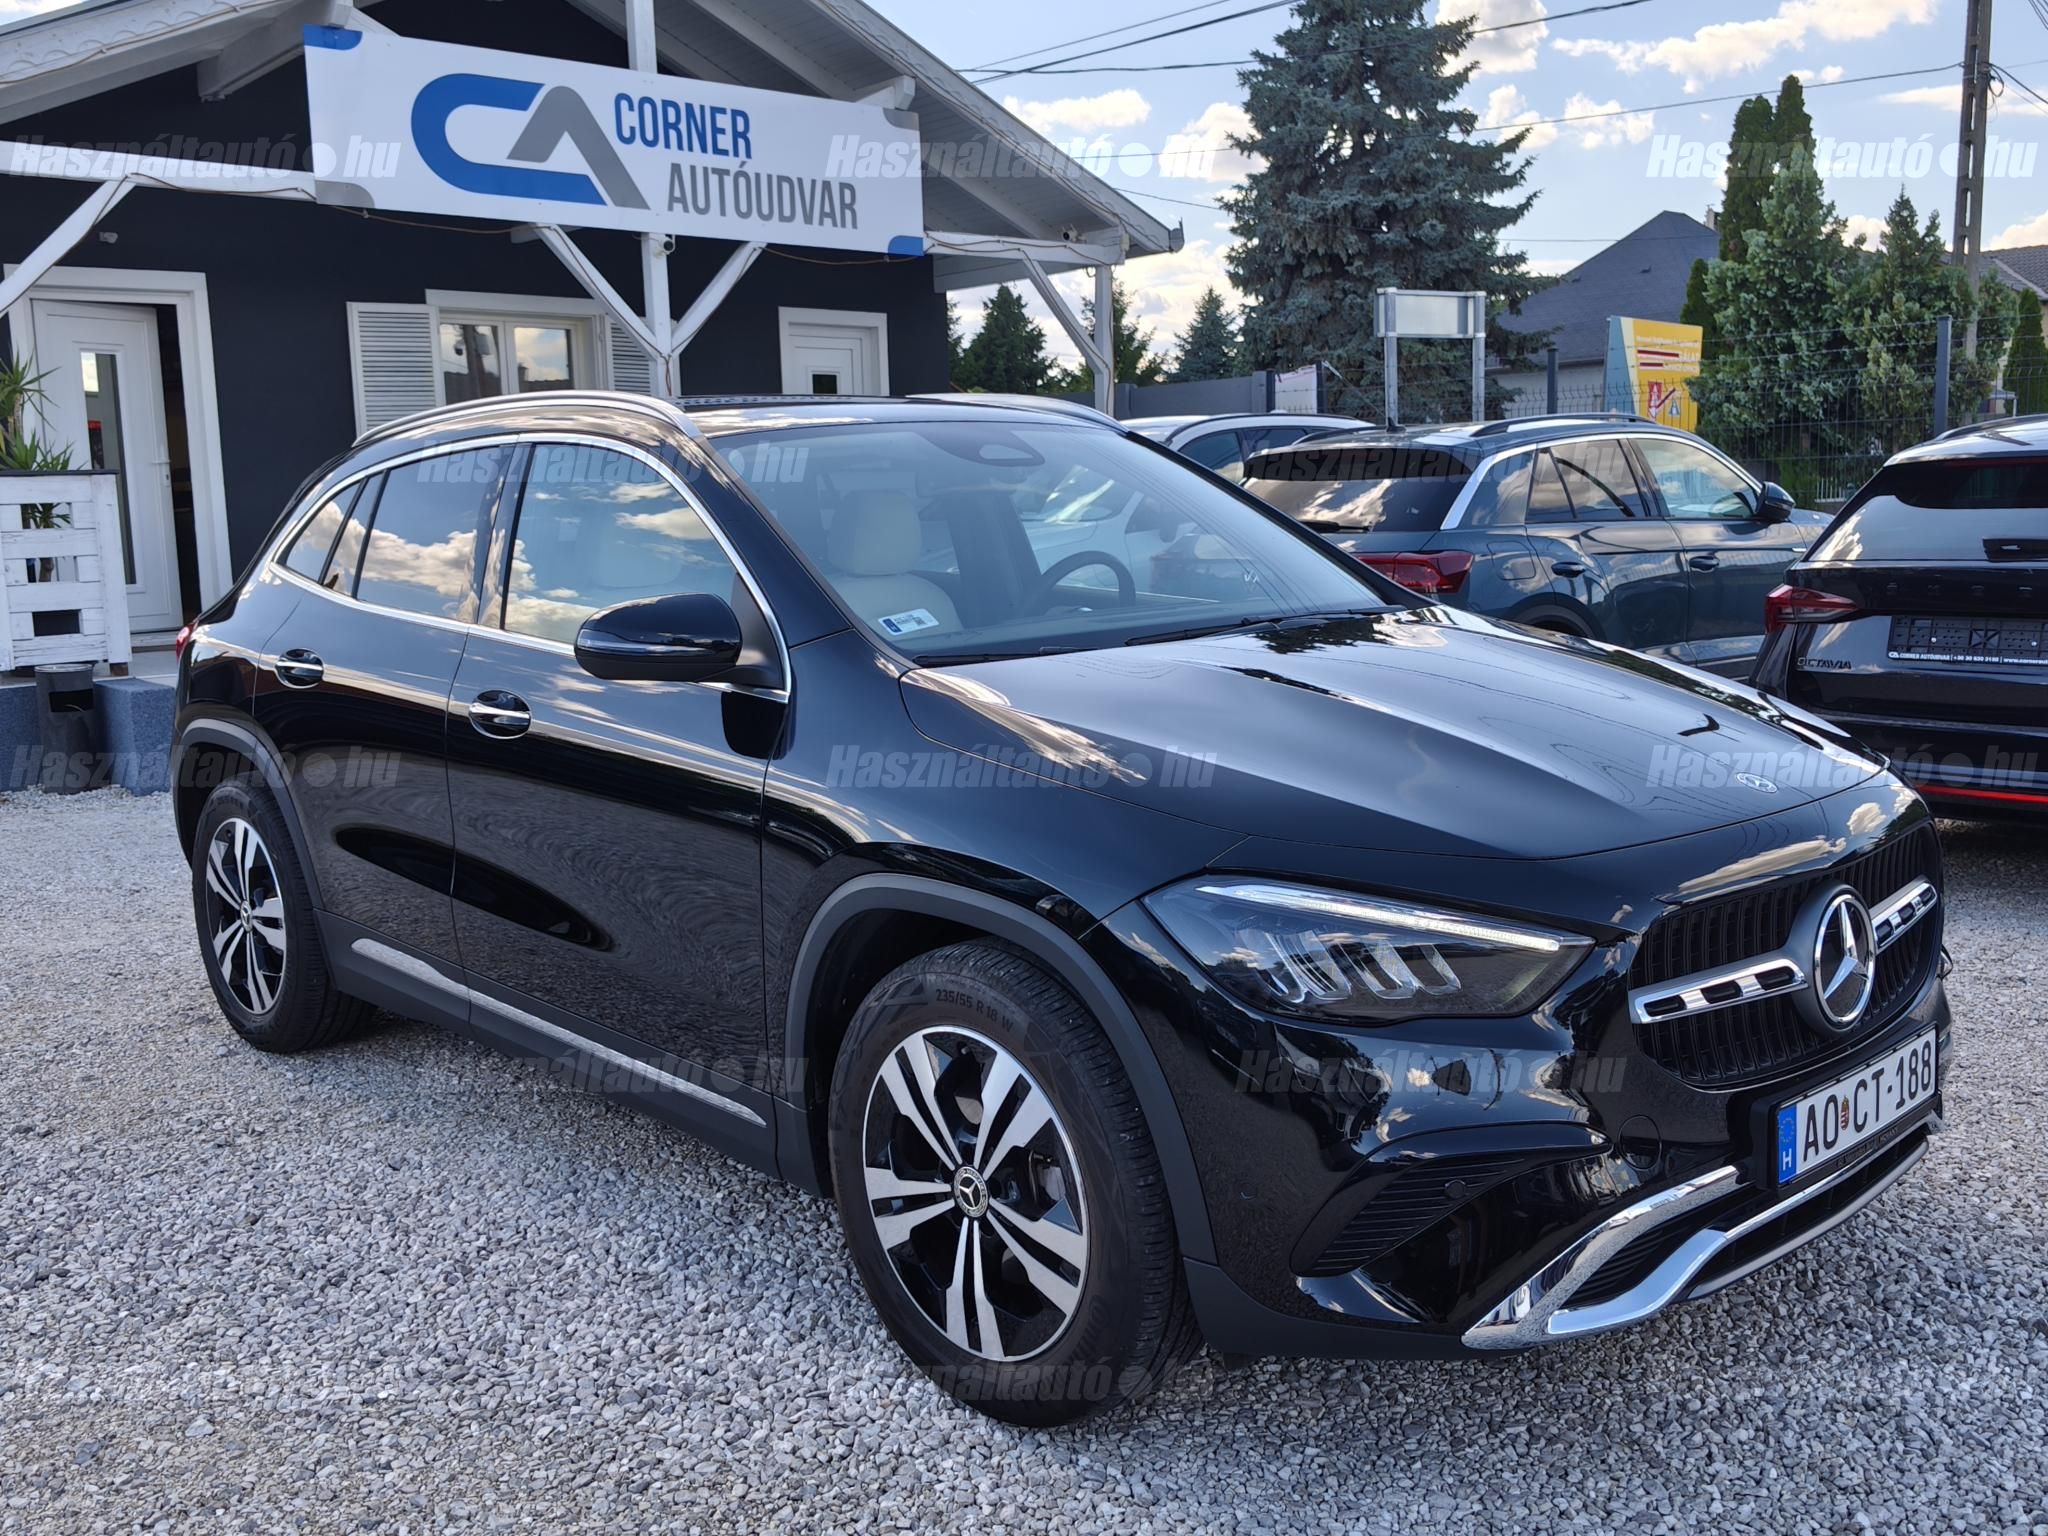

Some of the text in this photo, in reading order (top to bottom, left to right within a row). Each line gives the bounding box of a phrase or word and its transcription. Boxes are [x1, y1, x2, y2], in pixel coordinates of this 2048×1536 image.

[614, 91, 753, 160] CORNER
[667, 160, 858, 229] AUTÓUDVAR
[1797, 657, 1852, 670] OCTAVIA
[935, 988, 1014, 1033] 235/55 R 18 W
[1853, 1040, 1932, 1133] CT-188
[1782, 1148, 1793, 1172] H
